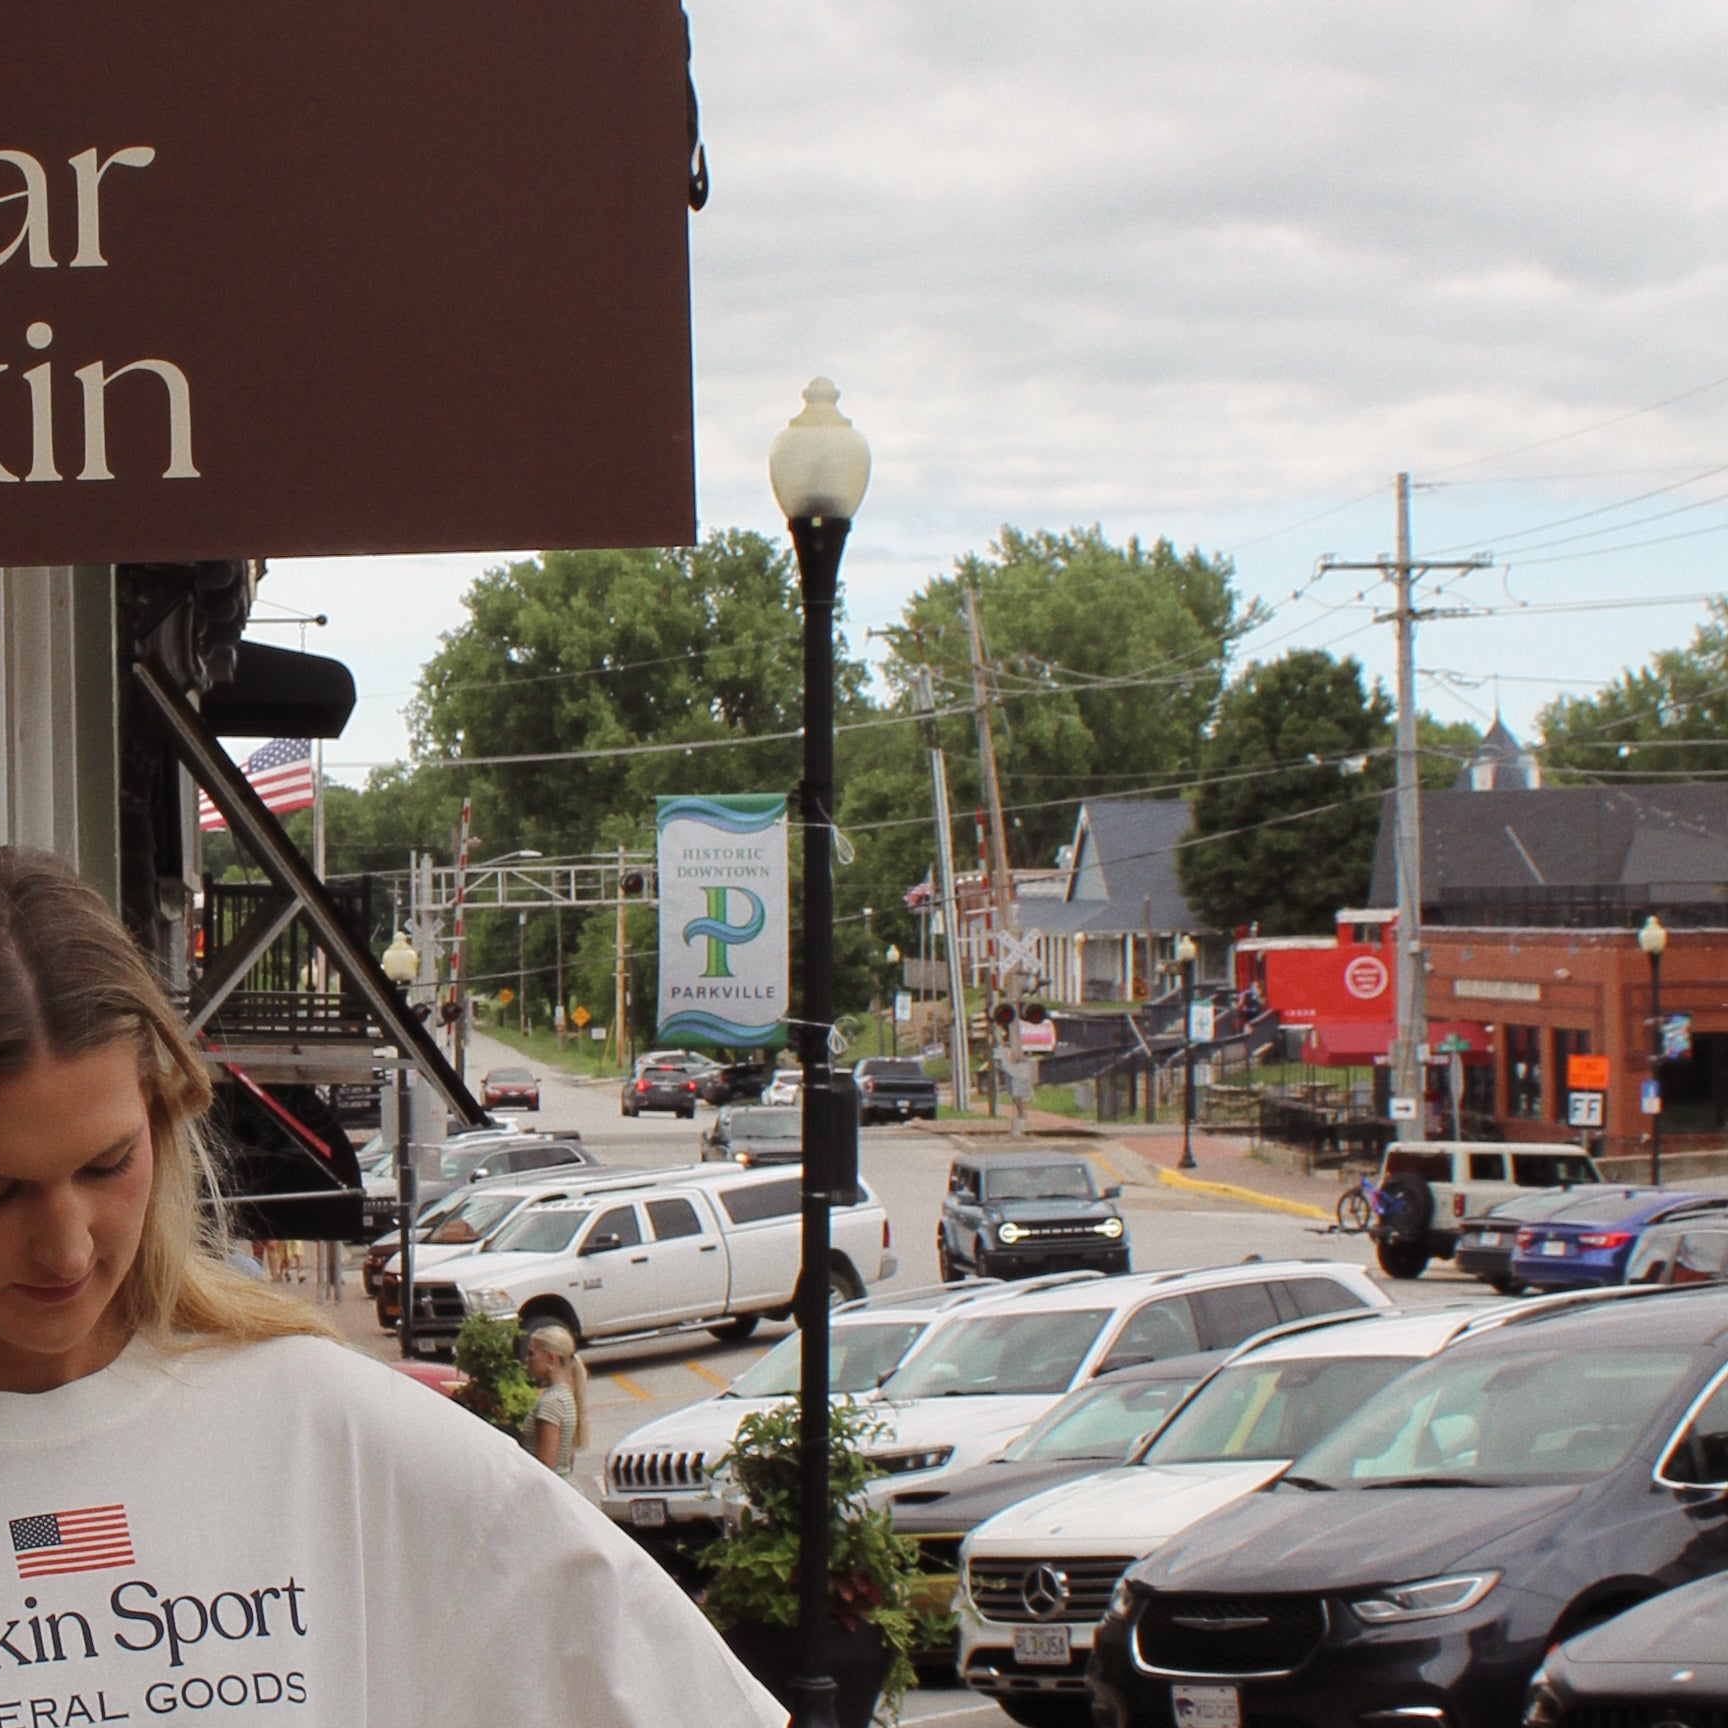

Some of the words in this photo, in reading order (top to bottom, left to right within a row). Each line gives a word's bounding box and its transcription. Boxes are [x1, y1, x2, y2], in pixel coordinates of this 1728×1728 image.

[682, 848, 764, 861] HISTORIC
[676, 866, 771, 878] DOWNTOWN
[682, 886, 766, 978] P
[671, 986, 775, 999] PARKVILLE
[1572, 1098, 1601, 1119] FF
[110, 1576, 308, 1667] Sport
[145, 1671, 307, 1714] GOODS
